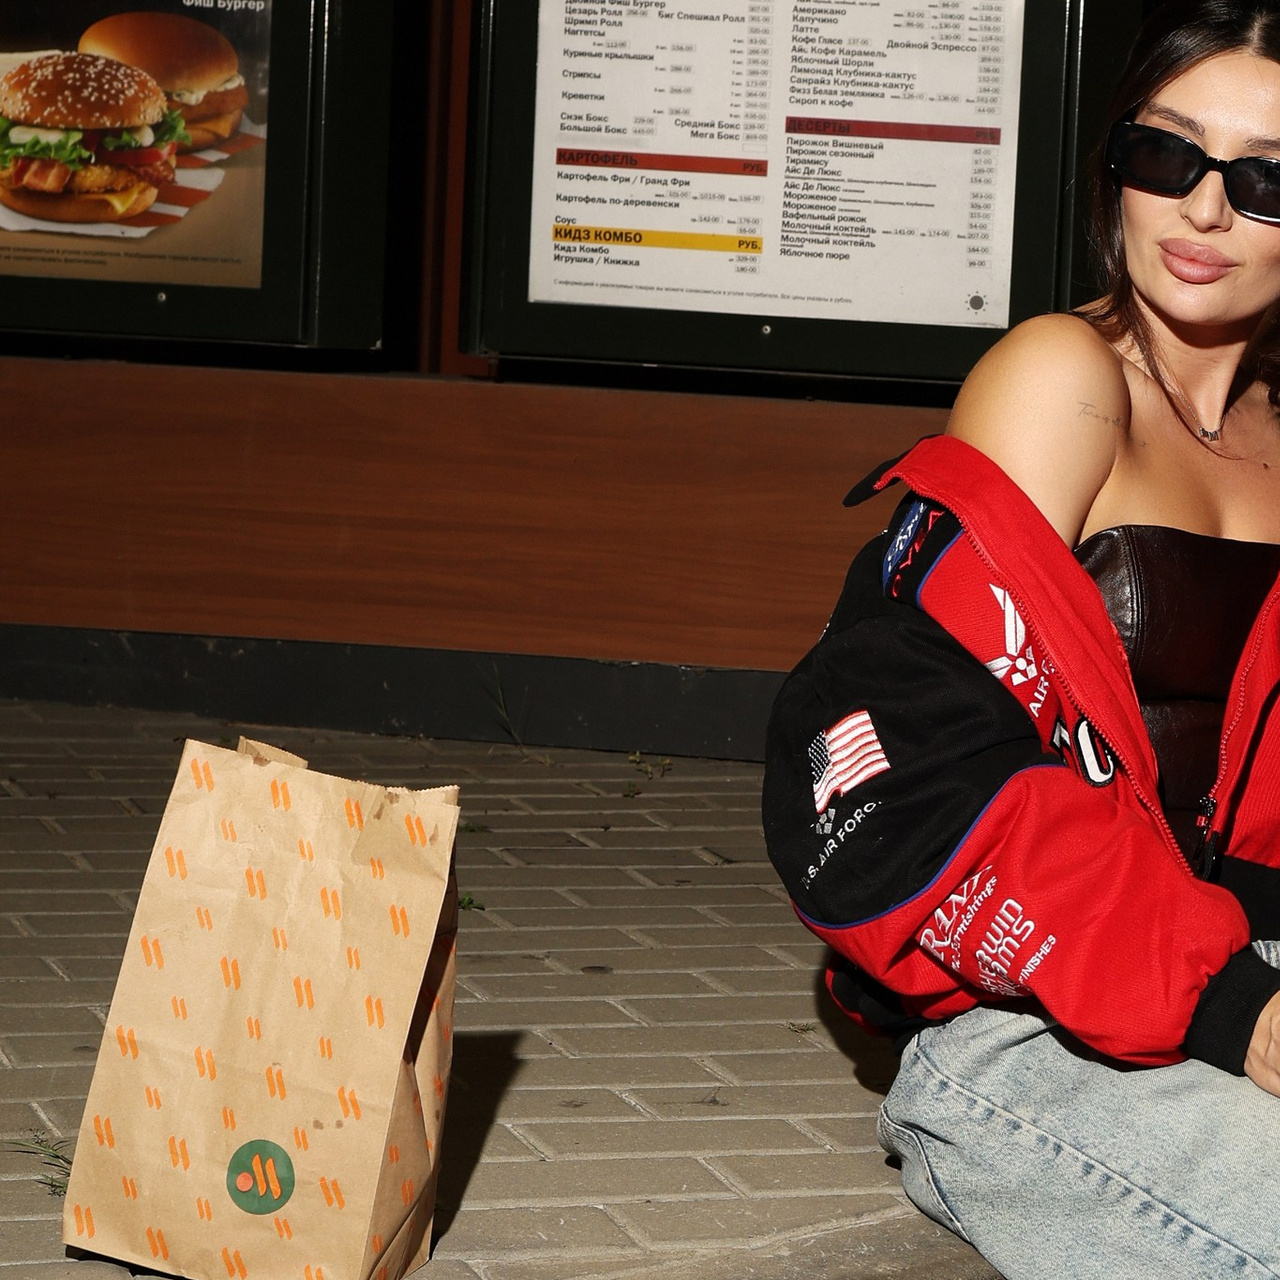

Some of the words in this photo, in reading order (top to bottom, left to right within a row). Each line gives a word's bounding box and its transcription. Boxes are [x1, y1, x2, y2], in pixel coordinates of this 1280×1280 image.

[565, 6, 599, 17] Цезарь
[600, 8, 623, 17] Ролл
[792, 5, 847, 16] Американо
[792, 15, 839, 26] Капучино
[791, 24, 820, 34] Латте
[886, 39, 929, 51] Двойной
[931, 41, 977, 53] Эспрессо
[791, 54, 840, 66] Яблочный
[842, 57, 875, 68] Шорли
[562, 70, 601, 80] Стрипсы
[790, 65, 834, 77] Лимонад
[836, 67, 917, 81] Клубника-кактус
[561, 91, 605, 101] Креветки
[785, 156, 829, 168] Тирамису
[557, 172, 609, 183] Картофель
[611, 174, 631, 184] Фри
[640, 175, 668, 186] Гранд
[670, 177, 691, 187] Фри
[555, 193, 607, 205] Картофель
[609, 196, 680, 208] по-деревенски
[783, 191, 837, 202] Мороженое
[783, 201, 837, 212] Мороженое
[554, 215, 577, 225] Соус
[782, 210, 836, 223] Вафельный
[837, 213, 867, 224] рожок
[554, 228, 591, 242] КИДЗ
[594, 230, 643, 244] КОМБО
[554, 244, 577, 254] Кидз
[579, 245, 610, 255] Комбо
[738, 239, 761, 250] РУБ.
[779, 247, 824, 259] Яблочное
[825, 250, 850, 261] пюре
[553, 253, 594, 265] Игрушка
[603, 256, 640, 267] Книжка
